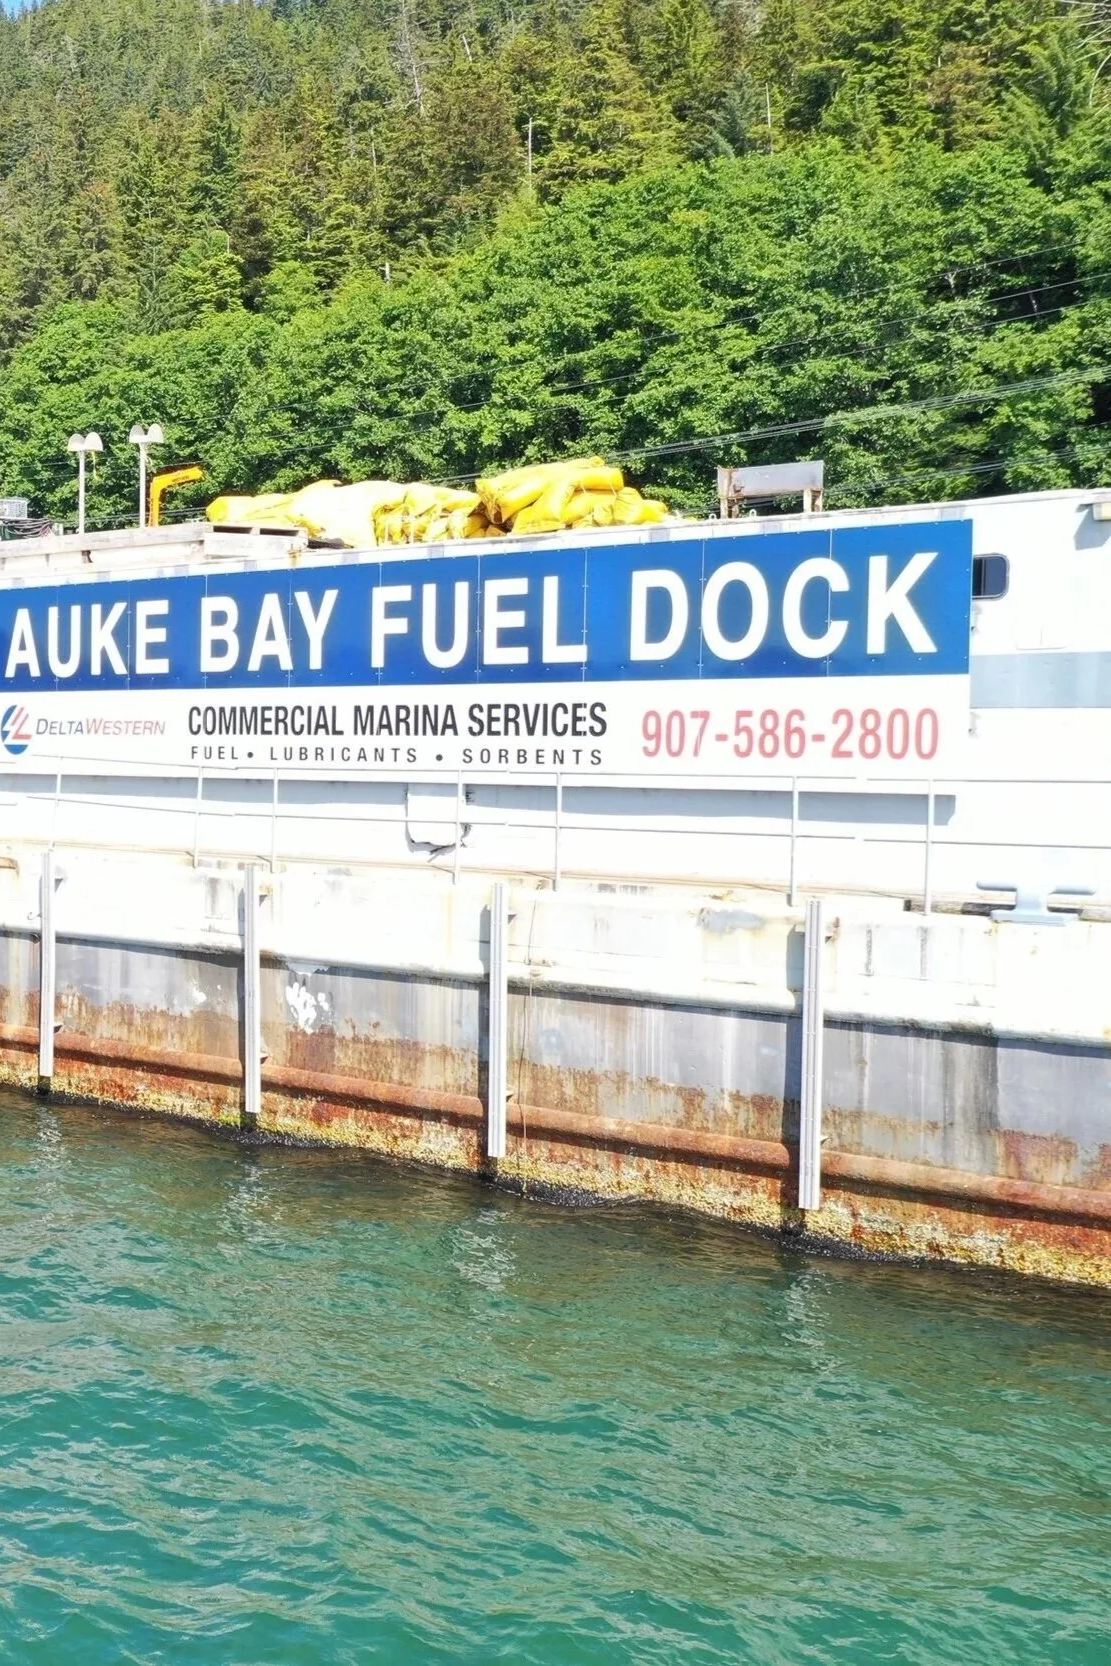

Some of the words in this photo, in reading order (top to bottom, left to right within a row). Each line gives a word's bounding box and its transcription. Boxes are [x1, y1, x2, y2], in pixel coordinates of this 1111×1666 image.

[4, 599, 170, 679] AUKE
[200, 588, 339, 673] BAY
[371, 575, 588, 669] FUEL
[629, 551, 938, 662] DOCK
[188, 705, 344, 736] COMMERCIAL
[353, 704, 459, 736] MARINA
[468, 702, 607, 737] SERVICES
[641, 707, 939, 760] 907-586-2800
[270, 746, 417, 763] LUBRICANTS
[462, 748, 602, 765] SORBENTS
